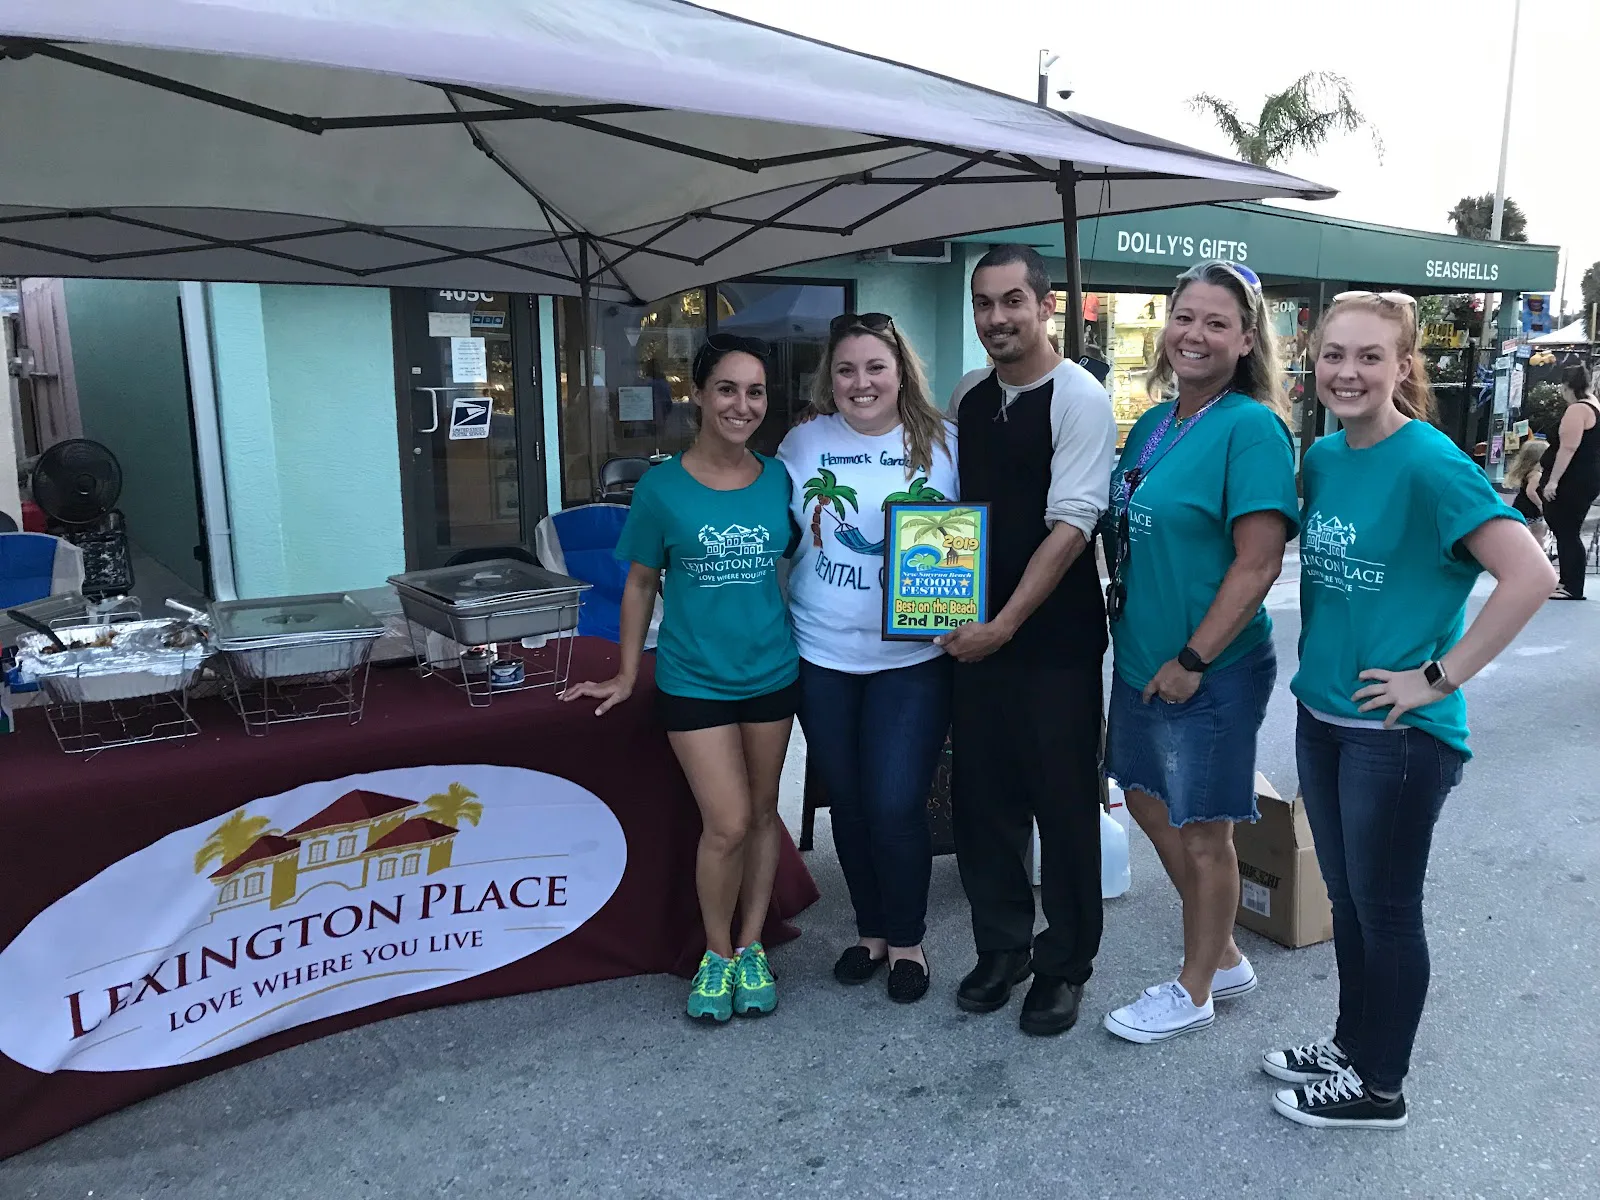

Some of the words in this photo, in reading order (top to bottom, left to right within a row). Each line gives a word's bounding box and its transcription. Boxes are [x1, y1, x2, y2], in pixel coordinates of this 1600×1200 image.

[1117, 230, 1194, 257] DOLLY'S
[1199, 238, 1248, 261] GIFTS
[1425, 259, 1499, 281] SEASHELLS
[821, 452, 872, 467] Hammock
[942, 534, 980, 551] 2019
[717, 572, 739, 581] WHERE
[741, 572, 756, 580] YOU
[815, 550, 871, 590] DENTAL
[1342, 561, 1385, 584] LACE
[915, 577, 957, 587] FOOD
[901, 586, 971, 597] FESTIVAL
[895, 598, 916, 614] Best
[918, 601, 930, 614] on
[932, 598, 948, 614] the
[949, 599, 977, 614] Beach
[897, 614, 928, 627] 2nd
[64, 893, 406, 1041] LEXINGTON
[418, 875, 569, 921] PLACE
[168, 987, 243, 1032] LOVE
[252, 953, 353, 998] WHERE
[362, 938, 419, 965] YOU
[429, 930, 483, 953] LIVE
